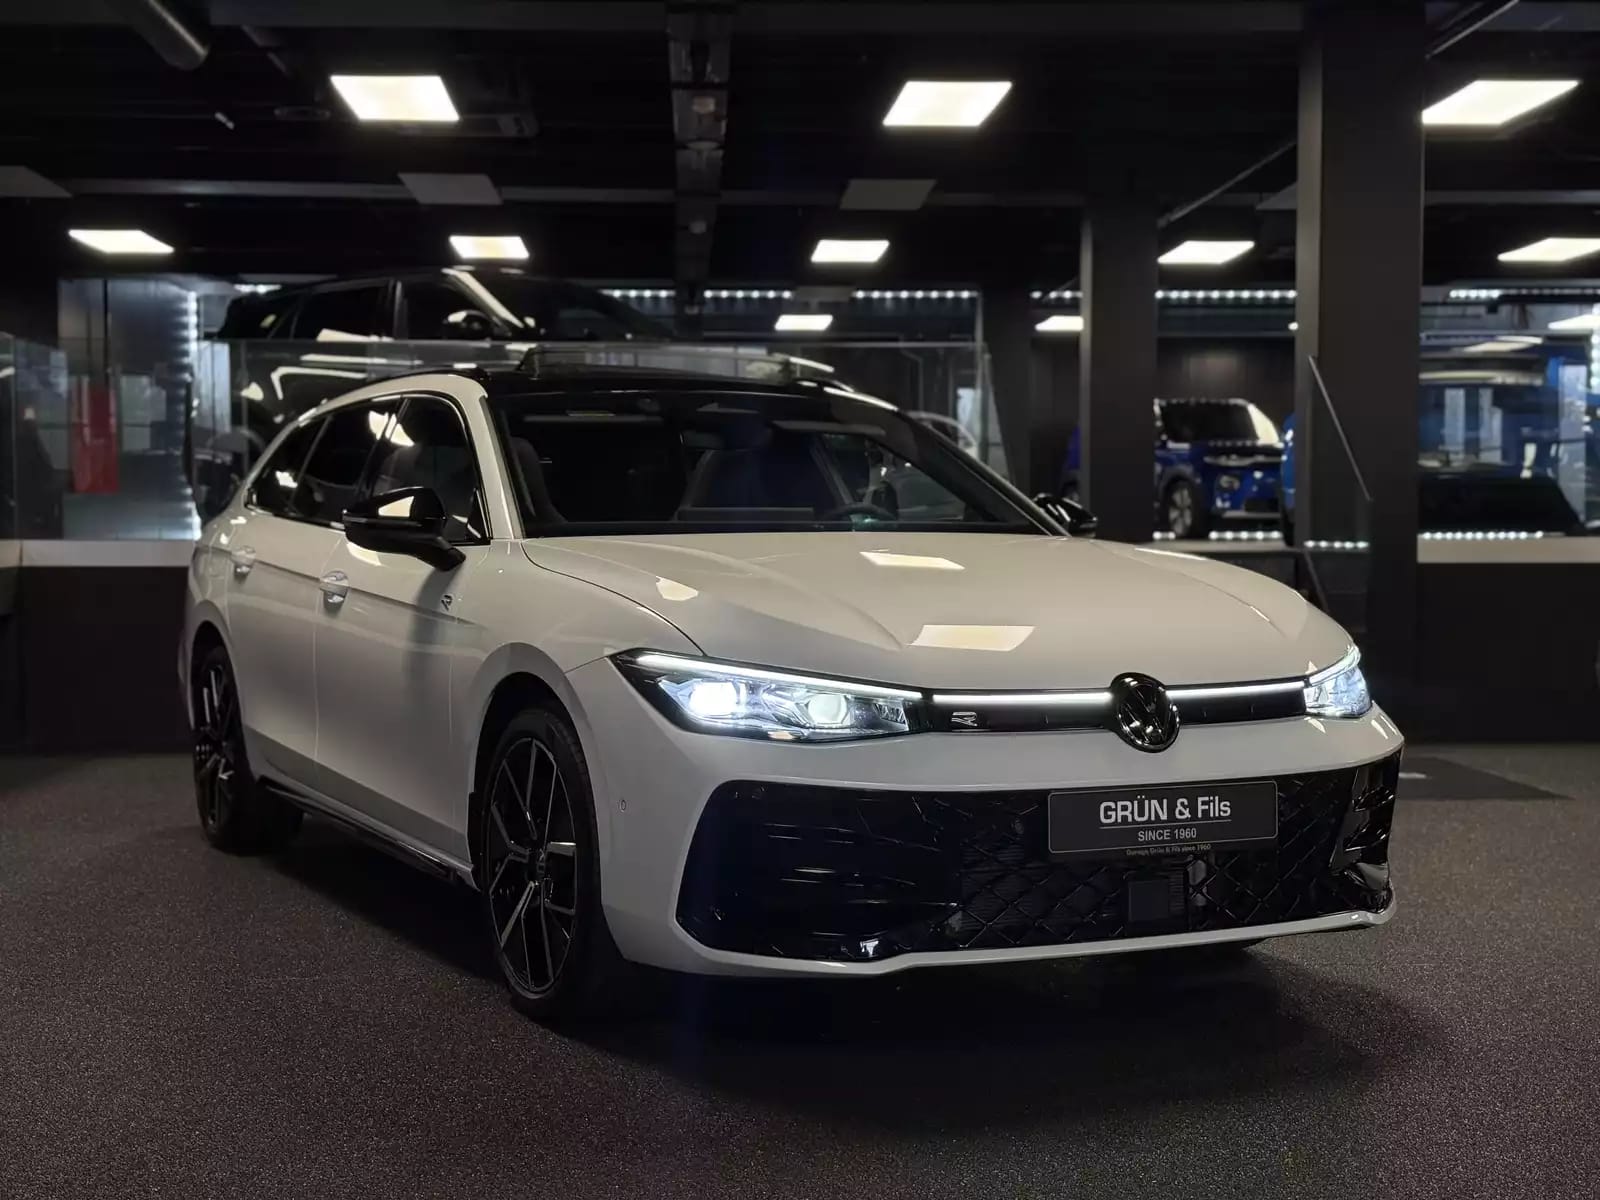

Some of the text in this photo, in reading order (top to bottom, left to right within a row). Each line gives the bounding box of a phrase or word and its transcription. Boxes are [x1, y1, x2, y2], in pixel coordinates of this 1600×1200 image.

[1099, 795, 1231, 824] GRÜN & Fils
[1137, 827, 1197, 842] SINCE 1960
